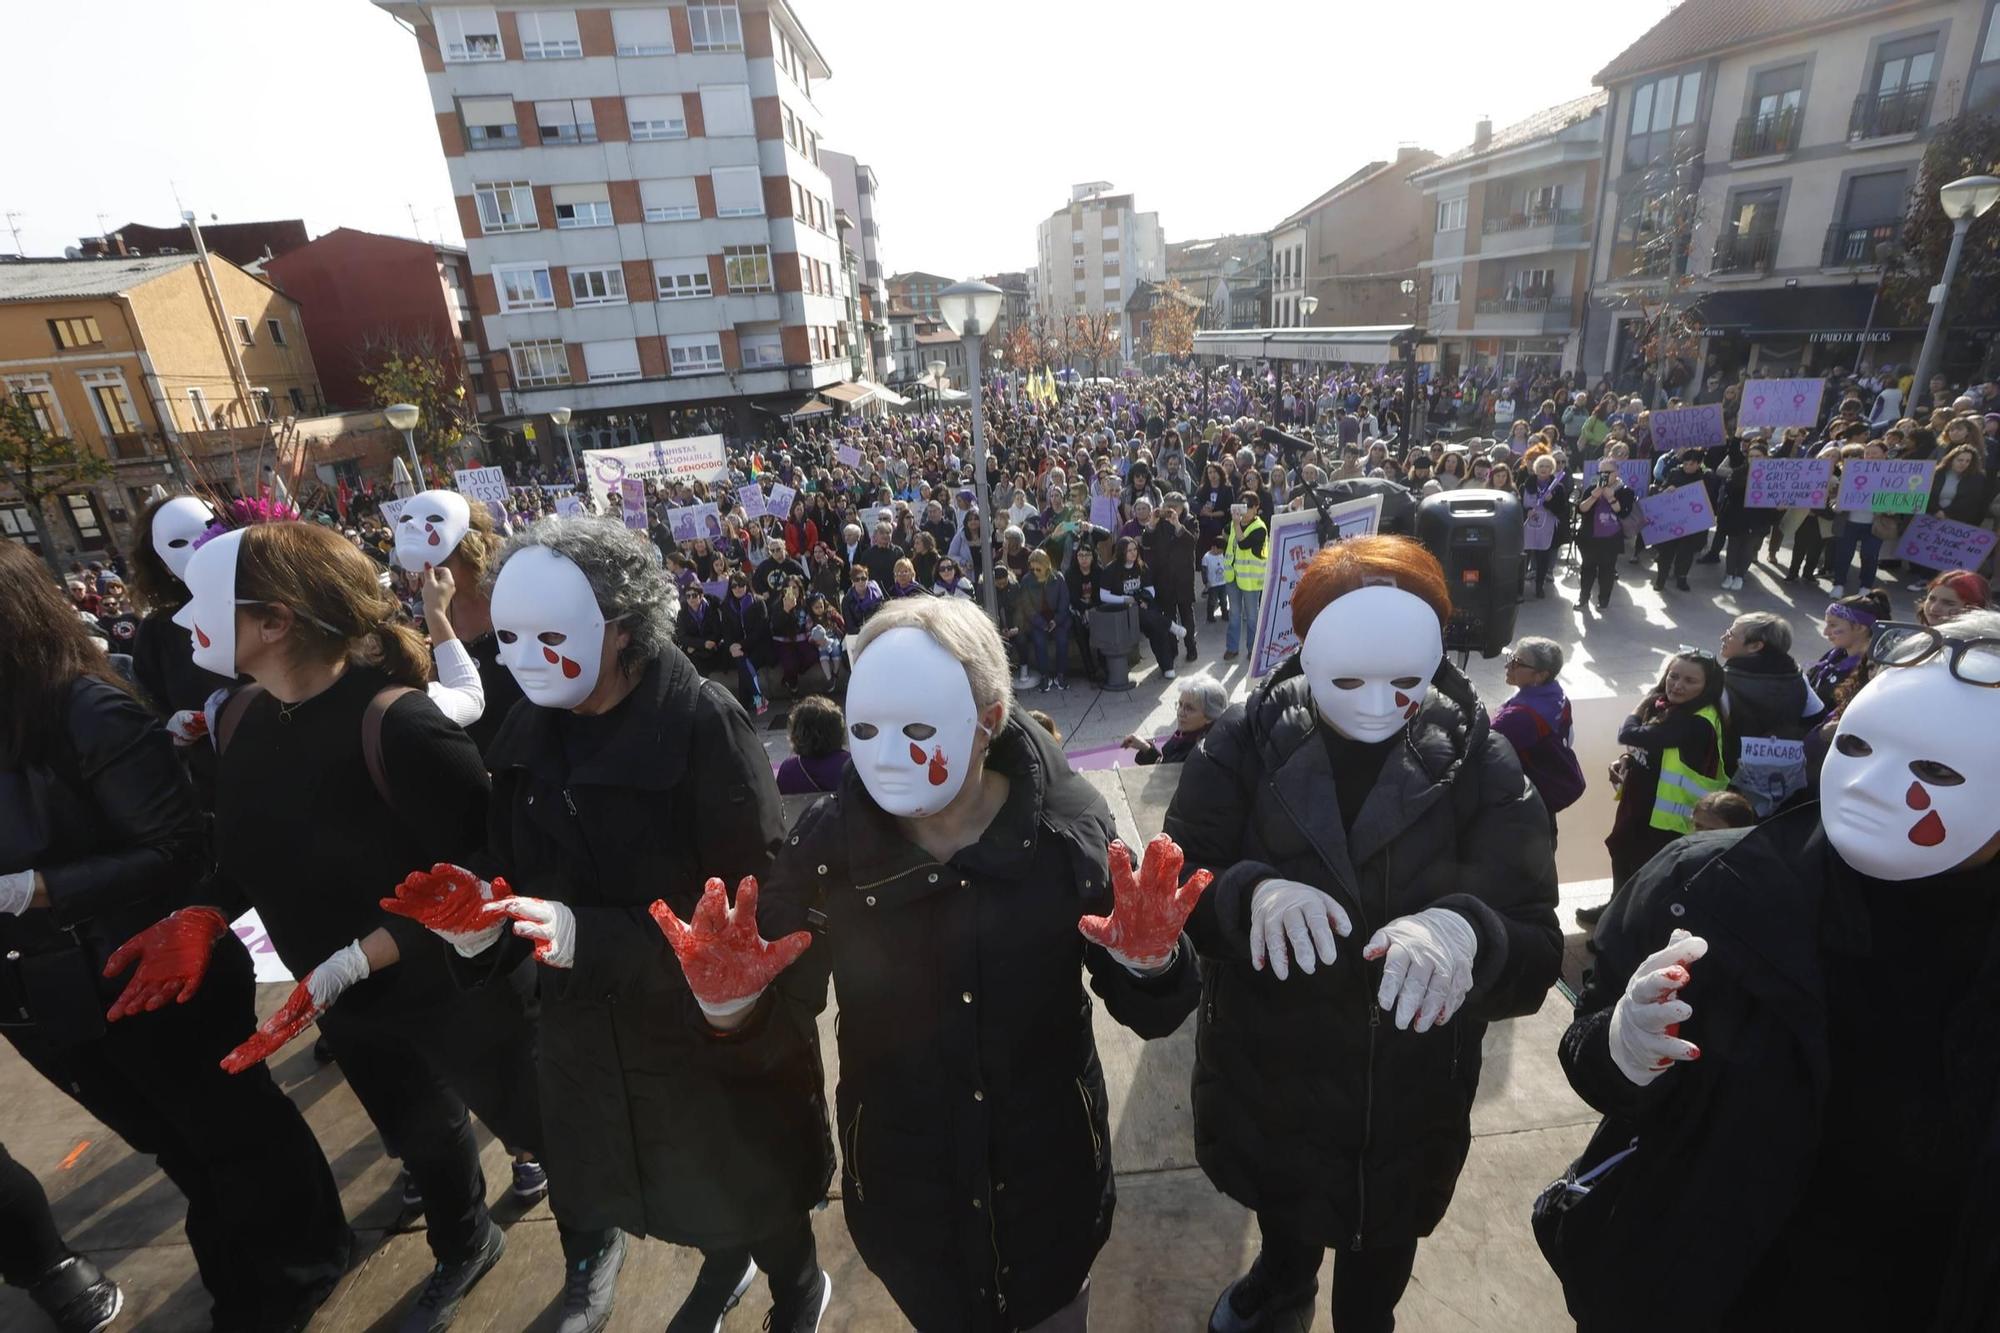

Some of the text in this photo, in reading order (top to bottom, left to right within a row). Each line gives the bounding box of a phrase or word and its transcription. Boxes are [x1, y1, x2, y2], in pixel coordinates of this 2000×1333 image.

[648, 446, 697, 457] FEMINISTAS
[635, 452, 713, 469] REVOLUCIONARIAS
[1758, 460, 1824, 472] SOMOS EL
[627, 470, 664, 480] CONTRA
[677, 460, 723, 473] GENOCIDIO
[1853, 461, 1925, 473] SIN LUCHA
[673, 474, 697, 482] GAZA
[1765, 471, 1800, 481] GRITO
[1767, 481, 1787, 490] LAS
[1791, 480, 1812, 490] QUE
[1815, 480, 1829, 489] YA
[1880, 476, 1905, 489] NO
[1844, 492, 1872, 505] HAY
[1917, 517, 1938, 531] SE
[1966, 546, 1982, 555] NO
